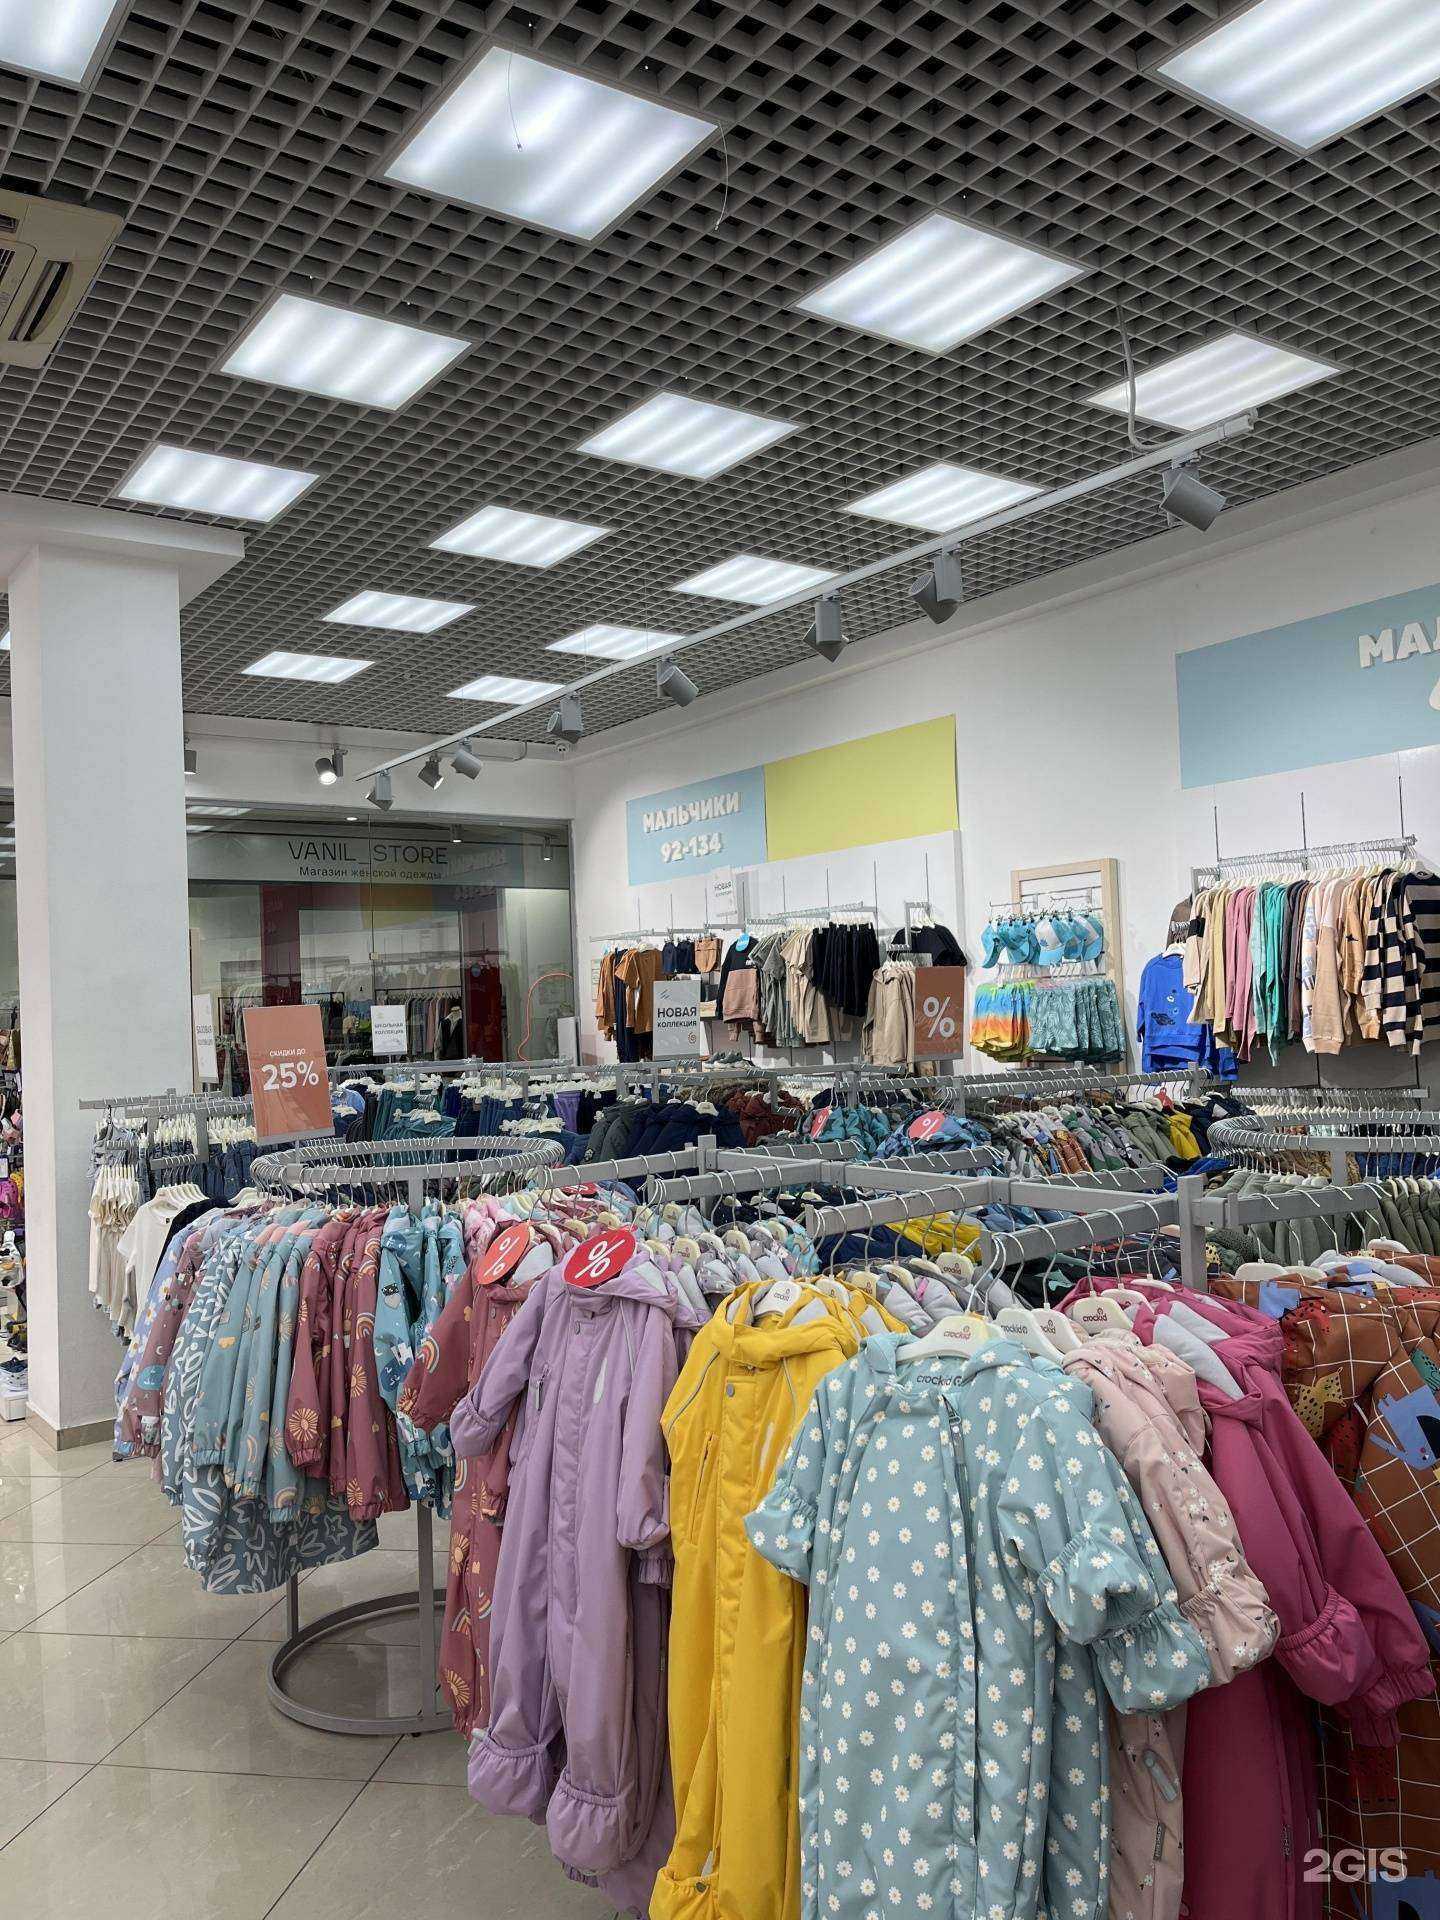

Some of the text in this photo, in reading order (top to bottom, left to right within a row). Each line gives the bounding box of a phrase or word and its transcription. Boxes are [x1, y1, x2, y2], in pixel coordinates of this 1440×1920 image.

[1358, 616, 1440, 668] МА
[642, 791, 740, 833] МАЛЬЧИКИ
[288, 840, 448, 865] VANIL_STORE
[661, 832, 722, 863] 92-134
[299, 866, 443, 880] Магазин женской одежды
[657, 1006, 697, 1018] НОВАЯ
[923, 996, 955, 1038] %
[269, 1048, 306, 1057] СКИДКИ ДО
[261, 1060, 320, 1091] 25%
[483, 1236, 521, 1277] %
[574, 1239, 626, 1280] %
[1000, 1323, 1022, 1334] rockid
[1083, 1313, 1107, 1322] crockid
[943, 1330, 971, 1340] crockid
[916, 1375, 953, 1386] crockid
